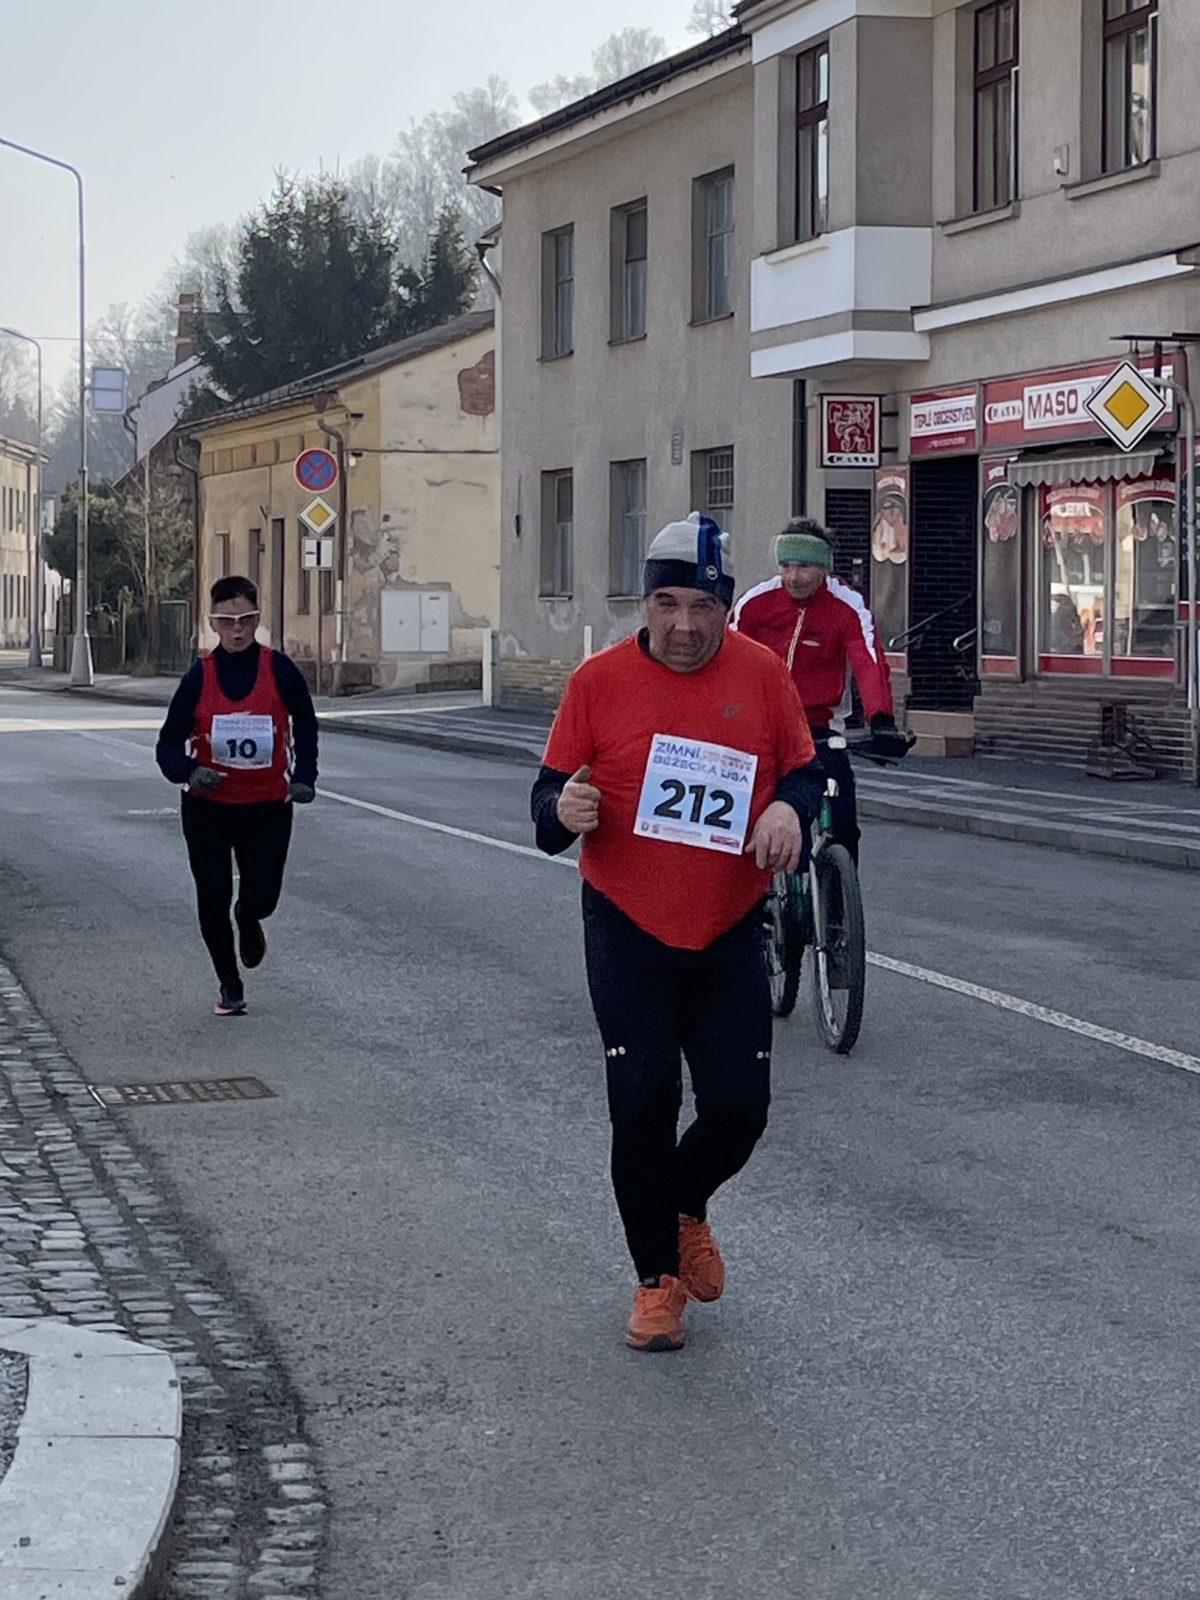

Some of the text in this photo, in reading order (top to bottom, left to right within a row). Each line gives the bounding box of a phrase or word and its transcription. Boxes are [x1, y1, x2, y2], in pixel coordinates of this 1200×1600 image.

[1028, 388, 1078, 421] MASO
[226, 739, 257, 758] 10
[656, 742, 702, 759] ZIMNÍ
[654, 779, 734, 830] 212
